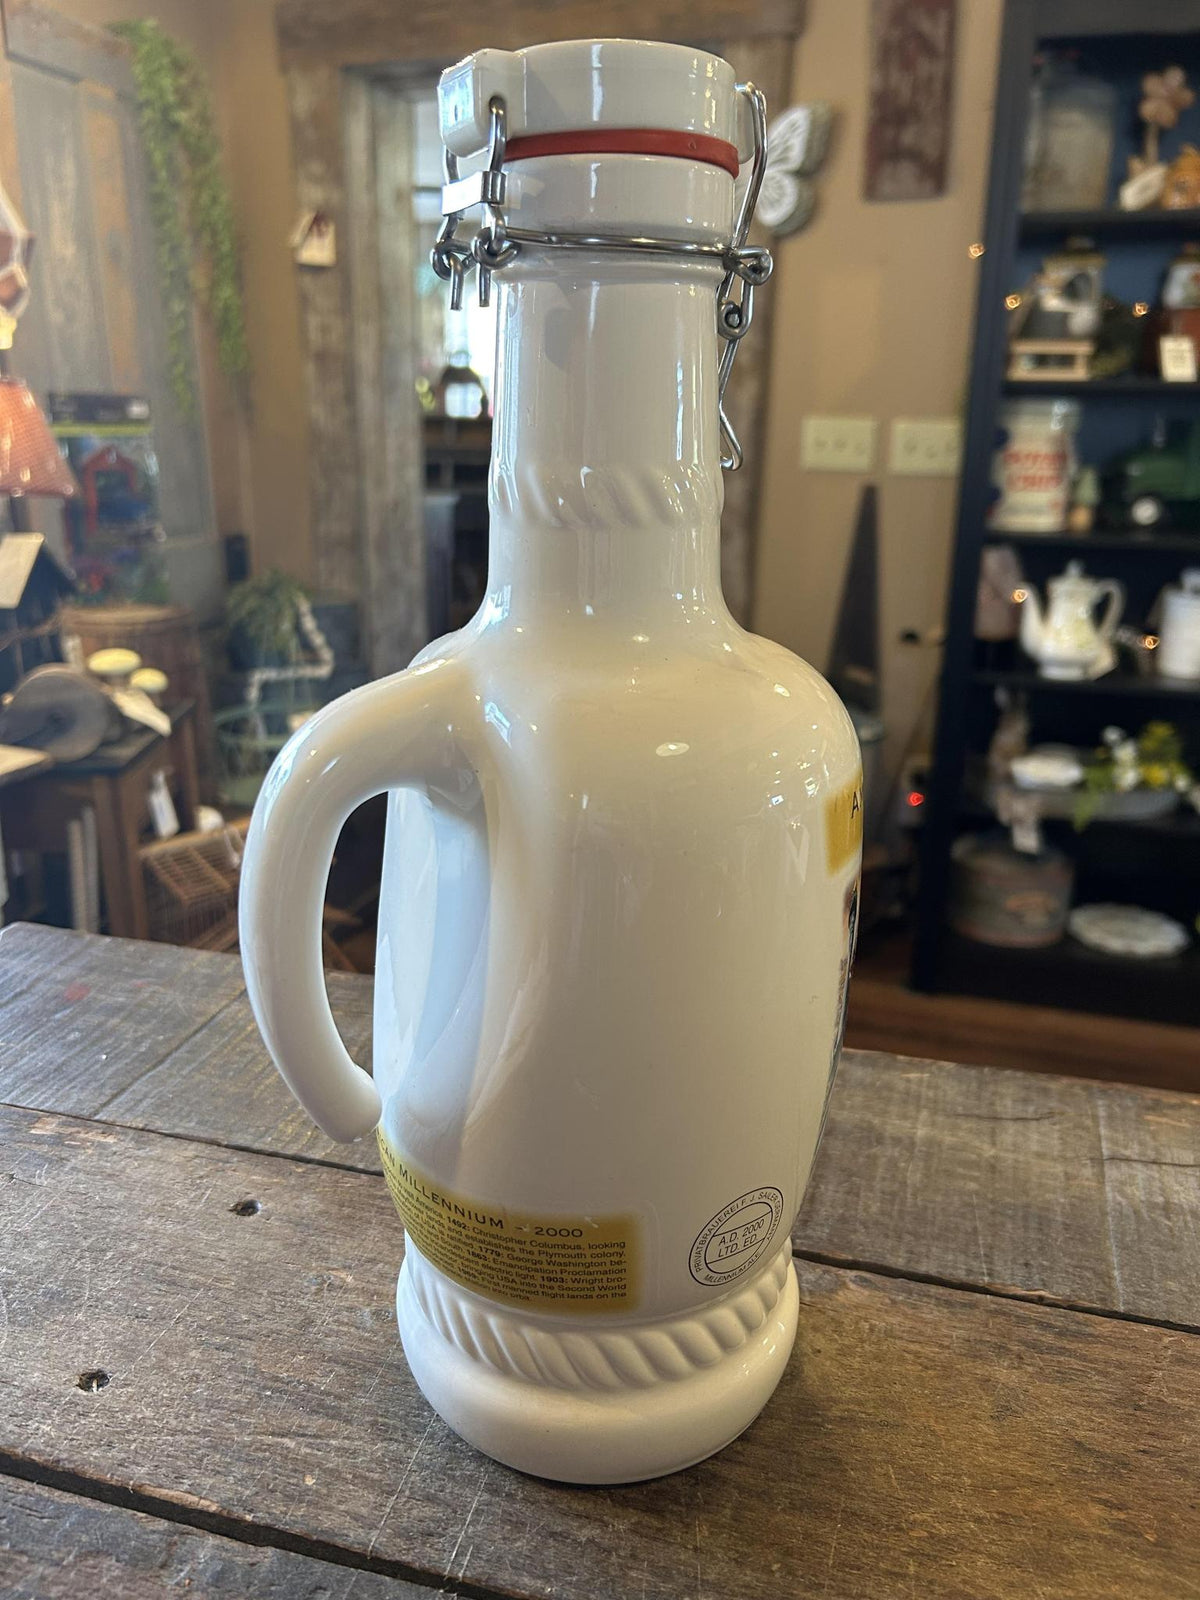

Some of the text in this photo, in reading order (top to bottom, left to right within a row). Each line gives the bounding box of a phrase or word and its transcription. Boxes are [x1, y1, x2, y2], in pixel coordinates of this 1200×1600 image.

[399, 1163, 504, 1229] MILLENNIUM
[534, 1226, 583, 1238] 2000
[472, 1226, 526, 1247] Christopher
[529, 1239, 586, 1251] Columbus,
[588, 1241, 626, 1250] looking
[694, 1202, 740, 1273] PRIVATBRAUEREI
[718, 1218, 765, 1247] A.D. 2000
[465, 1233, 516, 1252] establishes
[519, 1246, 535, 1256] the
[538, 1249, 587, 1259] Plymouth
[590, 1250, 626, 1259] colony.
[492, 1256, 558, 1275] Emancipation
[560, 1267, 627, 1276] Proclamation
[506, 1252, 544, 1267] George
[546, 1259, 607, 1269] Washington
[496, 1274, 517, 1286] USA
[518, 1280, 538, 1289] into
[539, 1282, 555, 1291] the
[557, 1284, 596, 1292] Second
[598, 1283, 627, 1292] World
[540, 1275, 568, 1284] 1903:
[570, 1277, 604, 1286] Wright
[606, 1275, 627, 1283] bro-
